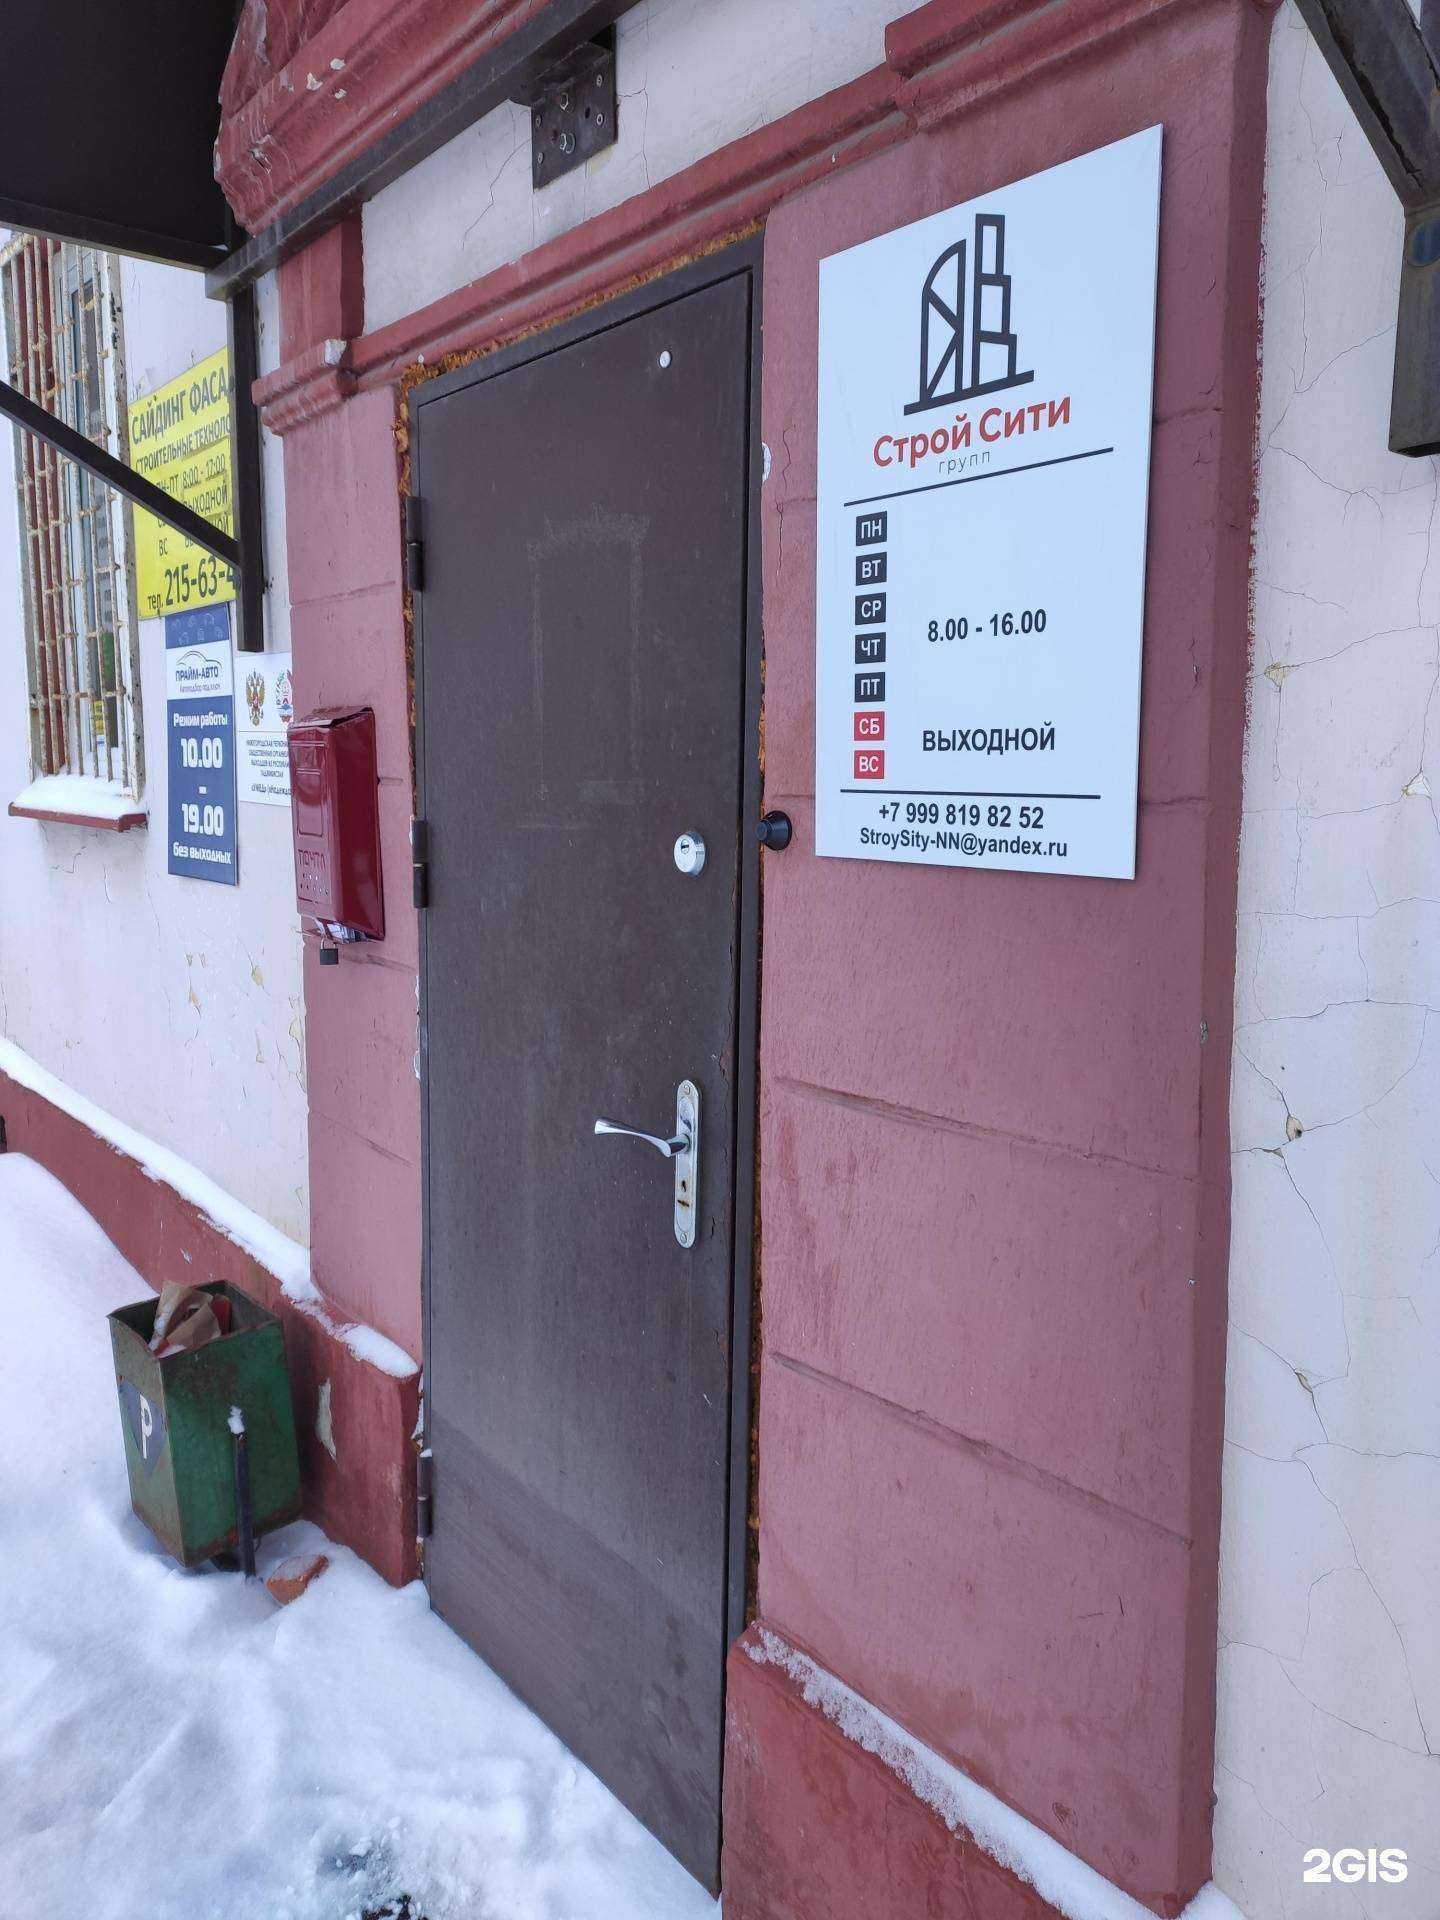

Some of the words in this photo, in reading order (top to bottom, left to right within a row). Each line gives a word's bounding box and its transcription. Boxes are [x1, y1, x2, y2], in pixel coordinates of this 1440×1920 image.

[132, 390, 186, 445] САЙДИНГ
[190, 366, 234, 415] ФАСА
[136, 434, 193, 474] СТРОИТЕЛЬНЫЕ
[194, 414, 231, 449] ТЕХНОЛО
[873, 412, 972, 468] Строй
[979, 397, 1070, 443] Сити
[938, 450, 991, 476] групп
[860, 518, 882, 539] ПН
[158, 538, 168, 557] ВС
[861, 559, 882, 579] ВТ
[147, 594, 164, 610] тел.
[165, 556, 237, 605] 215-63-4
[860, 599, 882, 618] СР
[927, 617, 968, 643] 8.00
[989, 609, 1047, 637] 16.00
[860, 638, 881, 656] ЧТ
[175, 666, 219, 682] ПРАЙМ-АВТО
[860, 678, 880, 696] ПТ
[173, 712, 200, 728] Режим
[201, 711, 228, 729] работы
[859, 717, 880, 736] СБ
[922, 721, 1056, 756] ВЫХОДНОЙ
[180, 737, 223, 769] 10.00
[859, 756, 879, 773] ВС
[181, 803, 224, 837] 19.00
[879, 803, 900, 822] +7
[906, 802, 939, 824] 999
[946, 804, 980, 826] 819
[987, 805, 1011, 827] 82
[1019, 807, 1044, 829] 52
[172, 842, 189, 858] без
[189, 845, 232, 865] выходных
[860, 827, 1068, 858] StroySity-NN@yandex.ru
